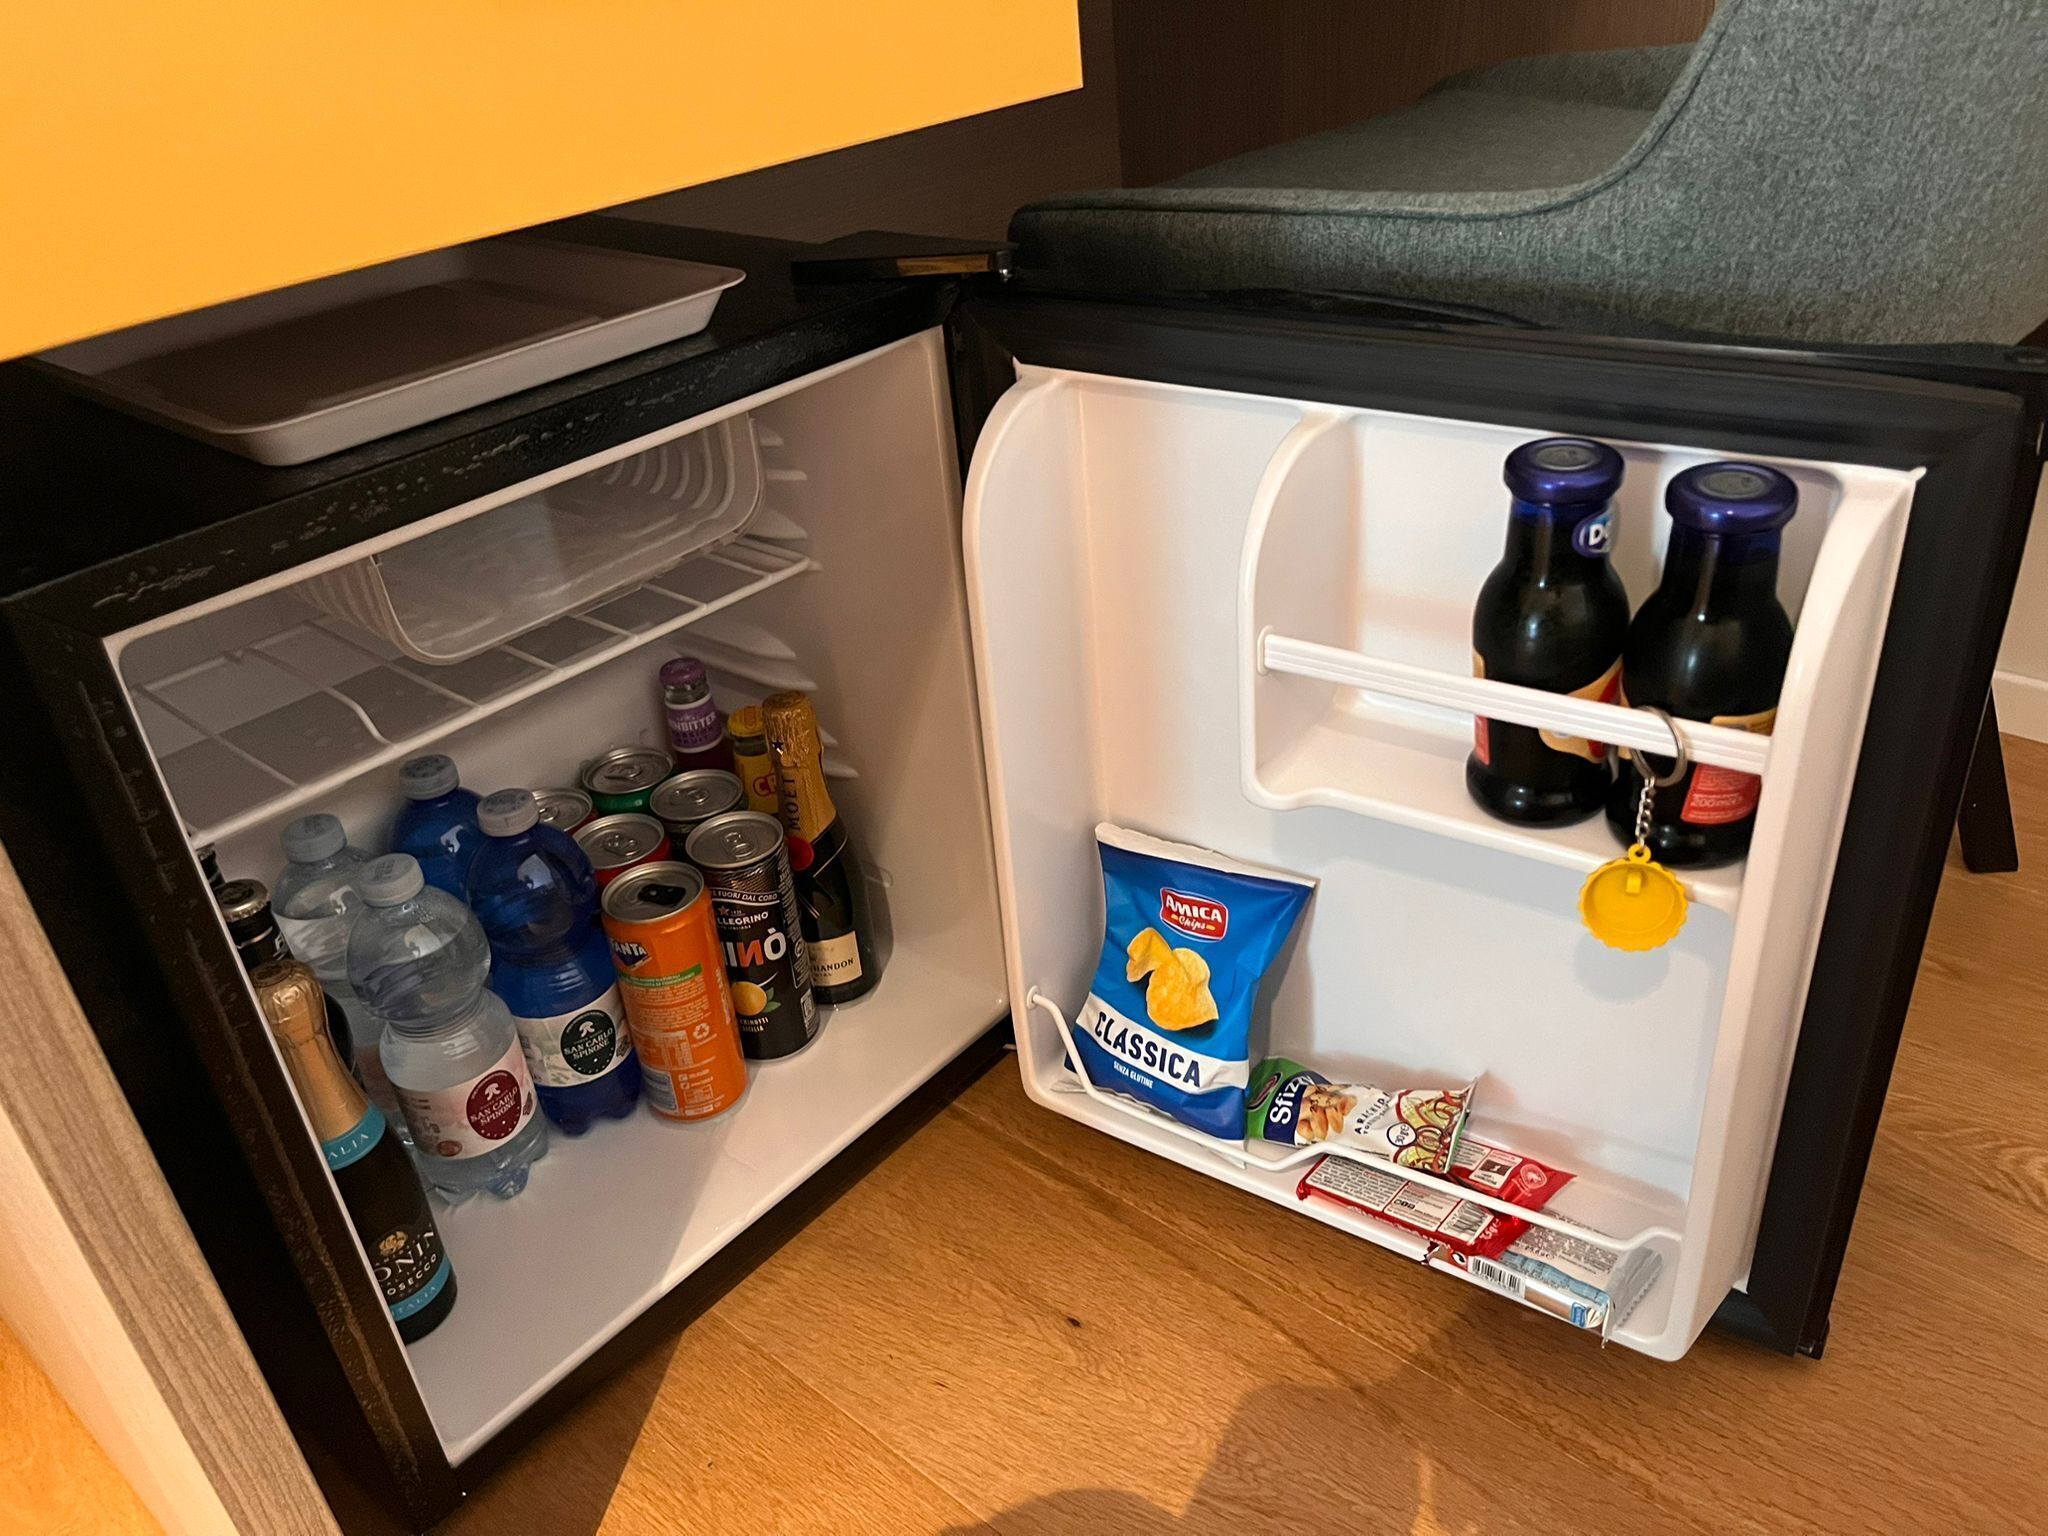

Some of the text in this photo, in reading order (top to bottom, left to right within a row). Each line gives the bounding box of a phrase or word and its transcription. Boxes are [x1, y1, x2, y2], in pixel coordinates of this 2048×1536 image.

[741, 893, 757, 902] DAL
[1165, 894, 1222, 923] AMICA
[1179, 916, 1206, 931] Chips
[563, 1043, 584, 1056] SAN
[585, 1027, 613, 1048] CARLO
[1094, 1011, 1201, 1088] CLASSICA
[1113, 1060, 1154, 1089] SENZA GLUTINE
[470, 1107, 492, 1123] SAN
[492, 1086, 518, 1111] CARLO
